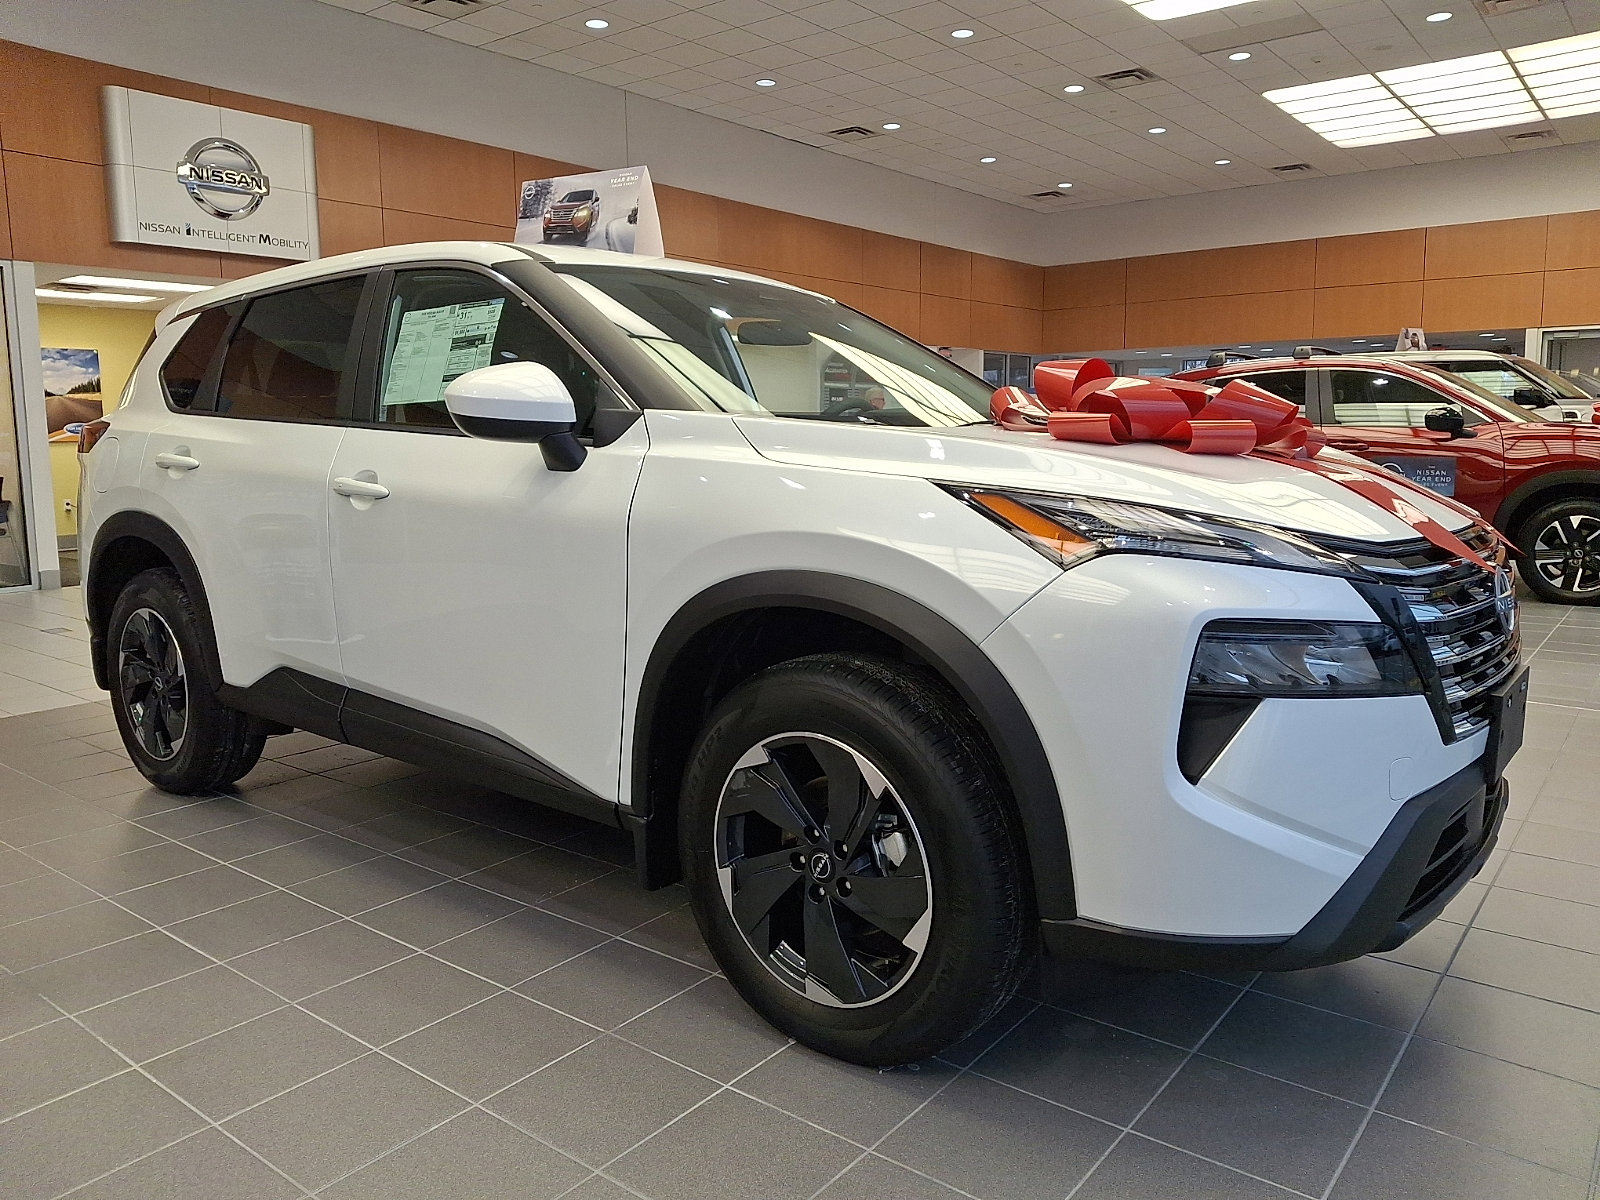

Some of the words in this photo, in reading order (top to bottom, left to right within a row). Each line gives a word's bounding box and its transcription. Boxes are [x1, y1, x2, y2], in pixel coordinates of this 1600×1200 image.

[189, 167, 263, 190] NISSAN
[610, 176, 625, 184] YEAR
[139, 221, 181, 235] NISSAN
